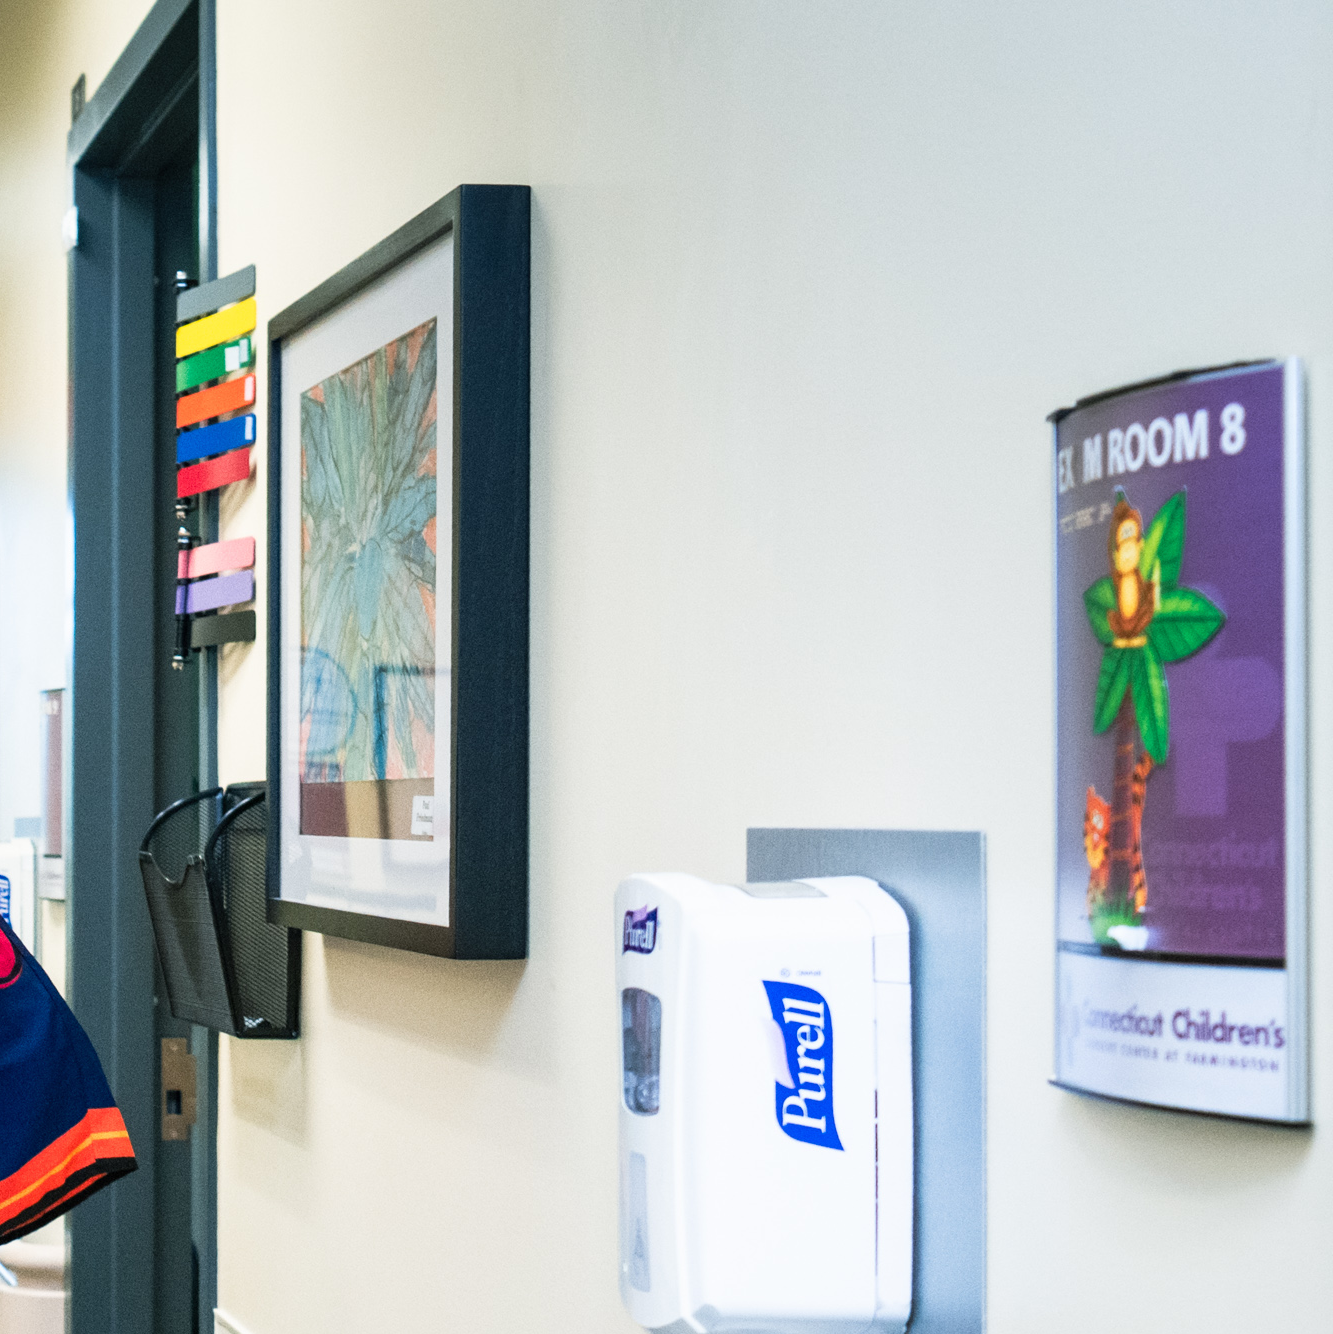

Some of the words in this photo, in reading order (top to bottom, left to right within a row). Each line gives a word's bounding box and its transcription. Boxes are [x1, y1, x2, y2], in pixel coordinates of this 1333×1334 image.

[1058, 433, 1103, 494] EXM
[1107, 408, 1209, 477] ROOM
[1219, 402, 1247, 456] 8
[782, 997, 827, 1134] Purell
[1172, 1008, 1286, 1049] Children's
